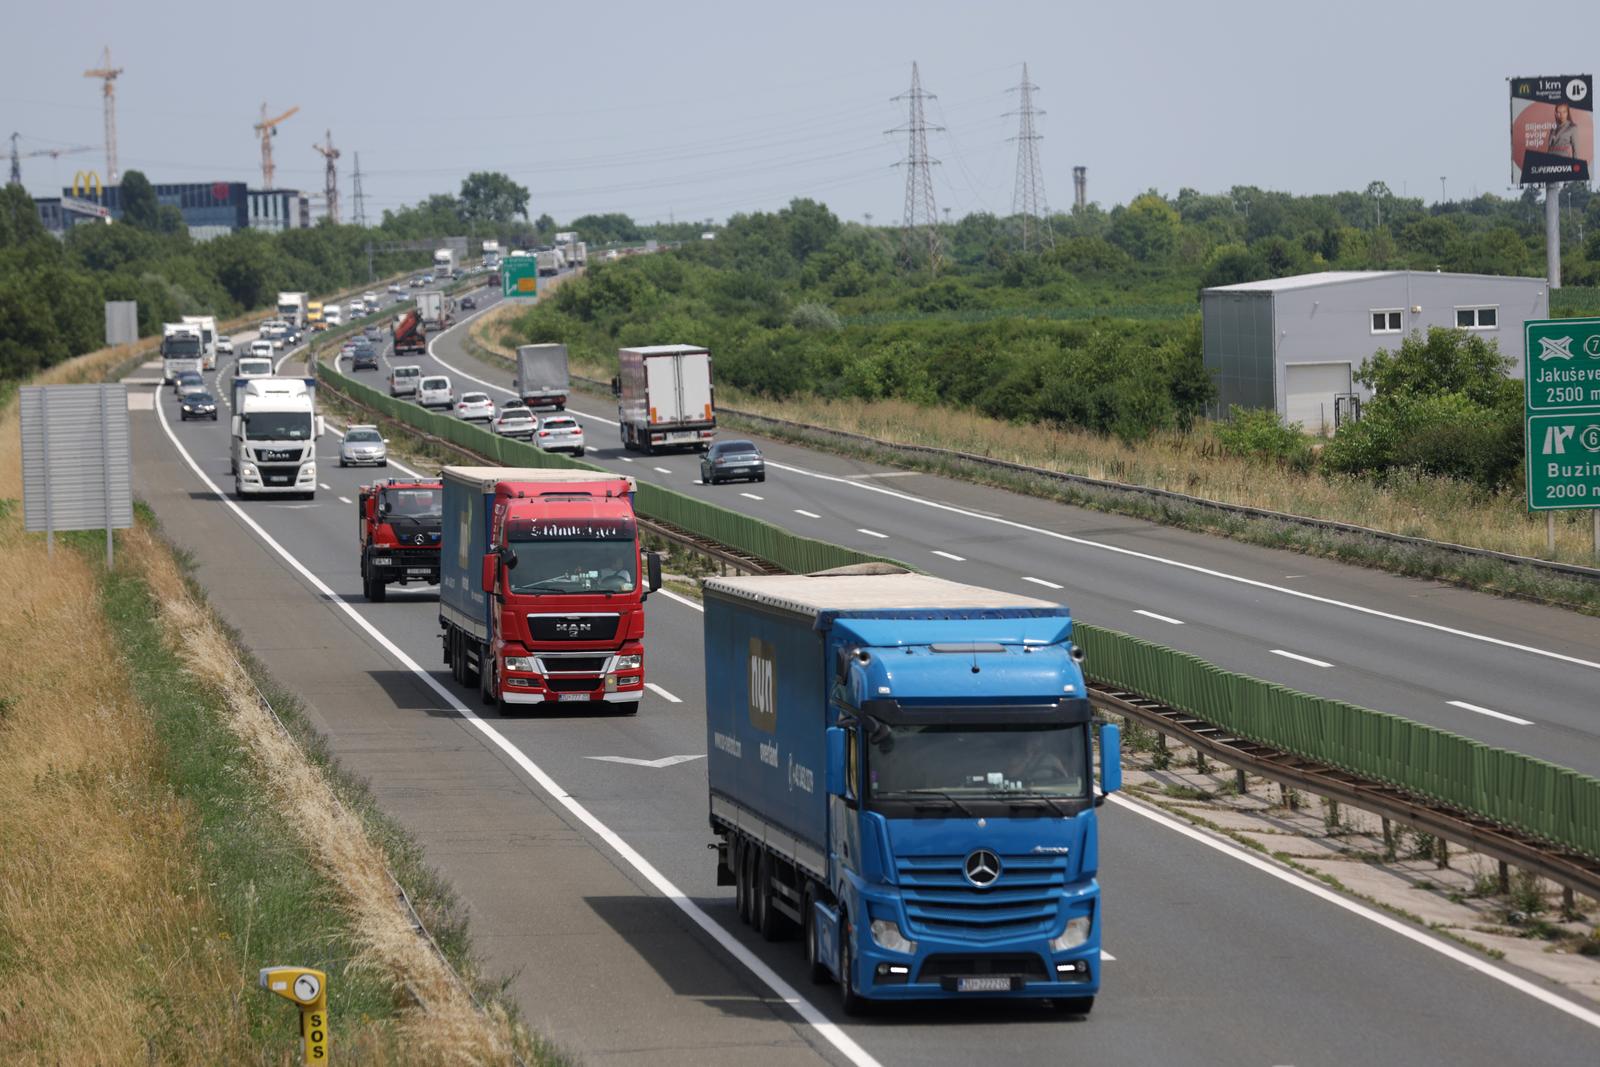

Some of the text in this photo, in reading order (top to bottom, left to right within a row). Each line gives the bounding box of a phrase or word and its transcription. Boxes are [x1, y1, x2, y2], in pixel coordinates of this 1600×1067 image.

[1539, 80, 1561, 90] 1 km
[1531, 165, 1573, 175] SUPERNOVA
[1592, 340, 1600, 352] 7
[1546, 386, 1584, 403] 2500
[1589, 431, 1598, 445] 6
[1547, 461, 1600, 478] Buzin
[1545, 483, 1587, 499] 2000
[556, 623, 591, 631] MAN
[310, 1014, 324, 1059] SOS
